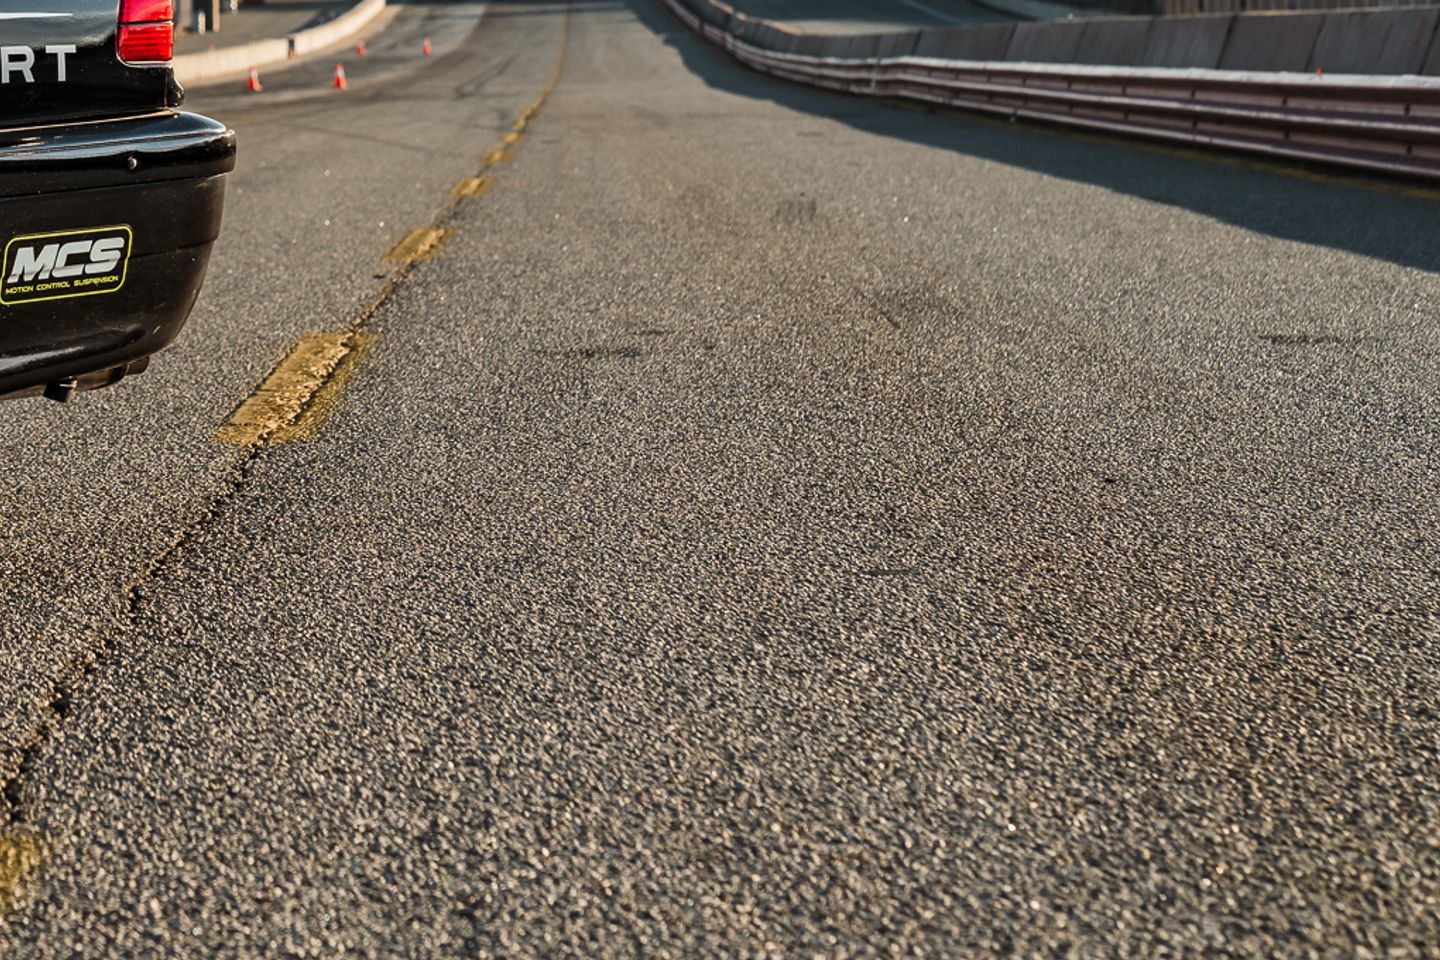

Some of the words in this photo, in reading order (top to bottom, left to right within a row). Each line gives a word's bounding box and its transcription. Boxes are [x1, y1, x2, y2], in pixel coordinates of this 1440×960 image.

[7, 237, 126, 284] MCS
[5, 285, 34, 295] MOTION
[36, 281, 71, 291] CONTROL
[73, 275, 120, 287] SUSPENSION
